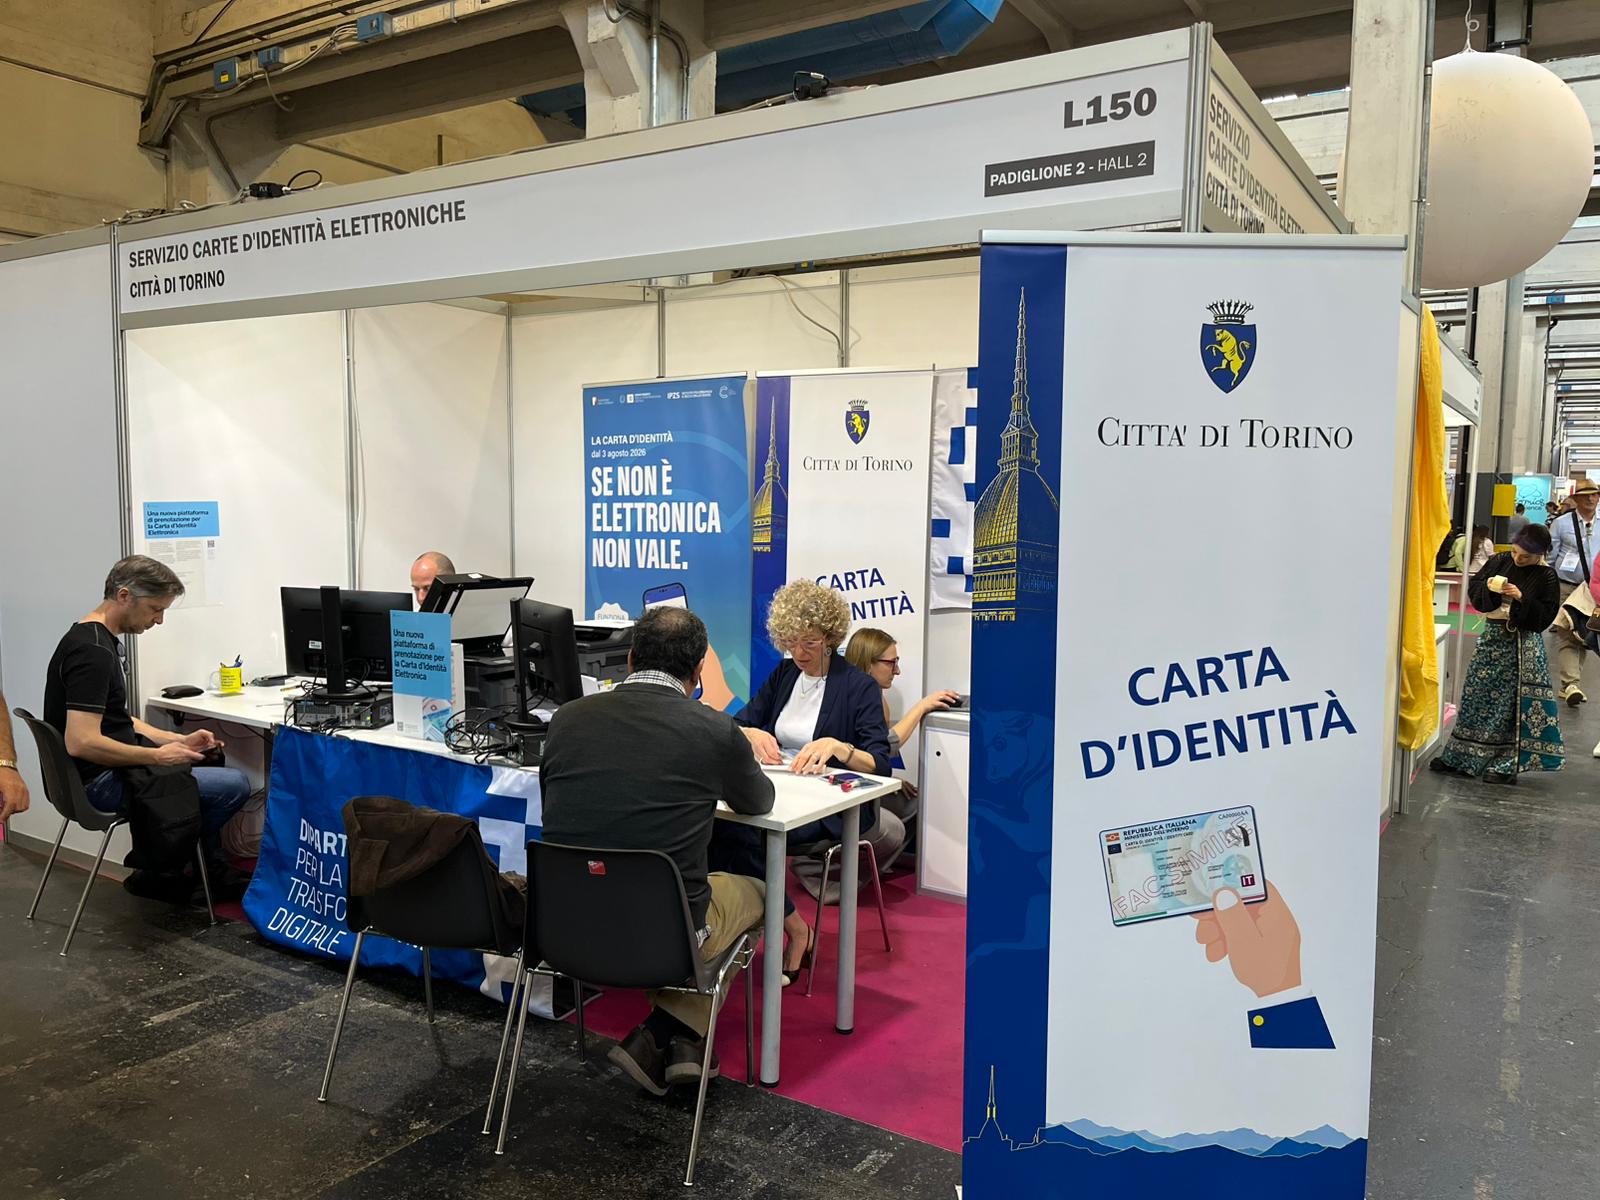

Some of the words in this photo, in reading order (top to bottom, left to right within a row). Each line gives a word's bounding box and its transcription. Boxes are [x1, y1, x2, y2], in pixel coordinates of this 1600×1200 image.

[1064, 87, 1158, 129] L150
[1209, 94, 1250, 161] SERVIZIO
[990, 163, 1073, 187] PADIGLIONE
[1075, 162, 1086, 175] 2
[1098, 155, 1133, 172] HALL
[1137, 152, 1147, 166] 2
[1208, 131, 1238, 184] CARTE
[1240, 164, 1278, 225] D'IDENTITÀ
[1206, 172, 1228, 209] CITTÀ
[1231, 193, 1239, 223] DI
[129, 243, 189, 268] SERVIZIO
[192, 235, 239, 259] CARTE
[242, 217, 326, 252] D'IDENTITÀ
[331, 200, 466, 240] ELETTRONICHE
[130, 274, 161, 298] CITTÀ
[164, 277, 176, 295] DI
[179, 270, 225, 291] TORINO
[591, 436, 602, 446] LA
[602, 434, 628, 445] CARTA
[629, 430, 673, 444] D'IDENTITÀ
[1199, 425, 1230, 448] DI
[1240, 419, 1353, 449] TORINO
[591, 449, 600, 458] dal
[602, 450, 606, 458] 3
[607, 448, 629, 459] agosto
[629, 447, 647, 457] 2026
[845, 460, 858, 471] DI
[862, 455, 913, 471] TORINO
[591, 466, 613, 496] SE
[617, 465, 657, 496] NON
[660, 459, 673, 496] È
[592, 501, 721, 533] ELETTRONICA
[592, 538, 631, 568] NON
[635, 538, 688, 570] VALE.
[848, 590, 915, 621] NTITÀ
[393, 629, 405, 637] Una
[406, 631, 424, 639] nuova
[393, 640, 428, 650] piattaforma
[429, 642, 435, 650] di
[394, 651, 433, 660] prenotazione
[401, 660, 417, 669] Carta
[395, 669, 427, 680] Elettronica
[1128, 646, 1290, 707] CARTA
[1080, 689, 1358, 779] D'IDENTITÀ
[300, 818, 348, 858] DIPART
[1122, 824, 1164, 836] REPUBBLICA
[1165, 819, 1197, 829] ITALIANA
[1124, 832, 1153, 840] MINISTERO
[295, 847, 317, 881] PER
[319, 860, 343, 888] LA
[1113, 875, 1165, 921] FAC
[1166, 816, 1254, 884] SIMILE
[1242, 876, 1253, 887] IT
[287, 876, 347, 922] TRASFO
[267, 907, 347, 955] DIGITALE
